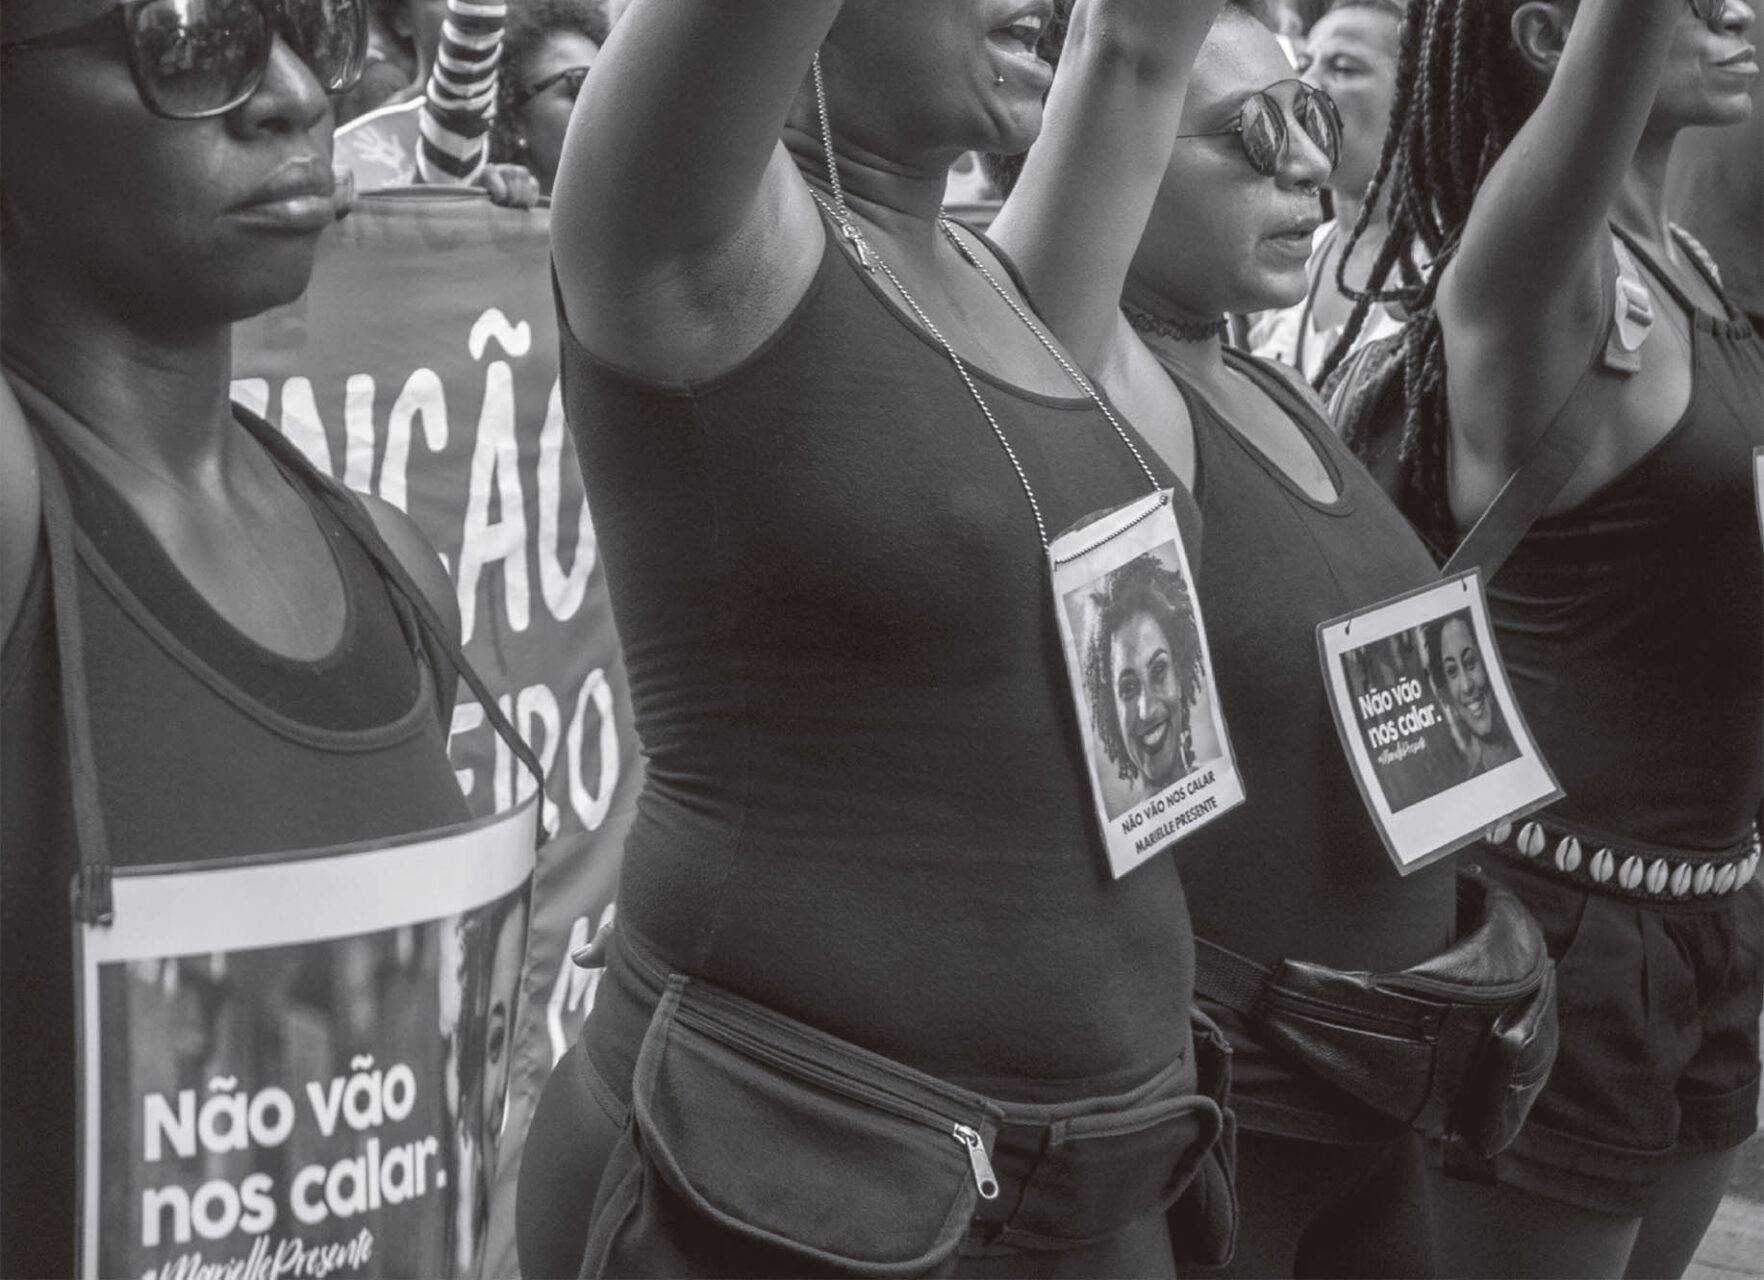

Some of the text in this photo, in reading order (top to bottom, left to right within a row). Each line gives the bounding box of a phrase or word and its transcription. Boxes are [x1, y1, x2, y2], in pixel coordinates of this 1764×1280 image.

[1358, 676, 1422, 720] Não vão
[1368, 720, 1399, 749] nos
[1121, 770, 1217, 835] NÃO VÃO NOS CALAR
[1134, 796, 1219, 855] MARIELLE PRESENTE
[142, 1053, 417, 1162] Não vão
[141, 1135, 447, 1247] nos calar.
